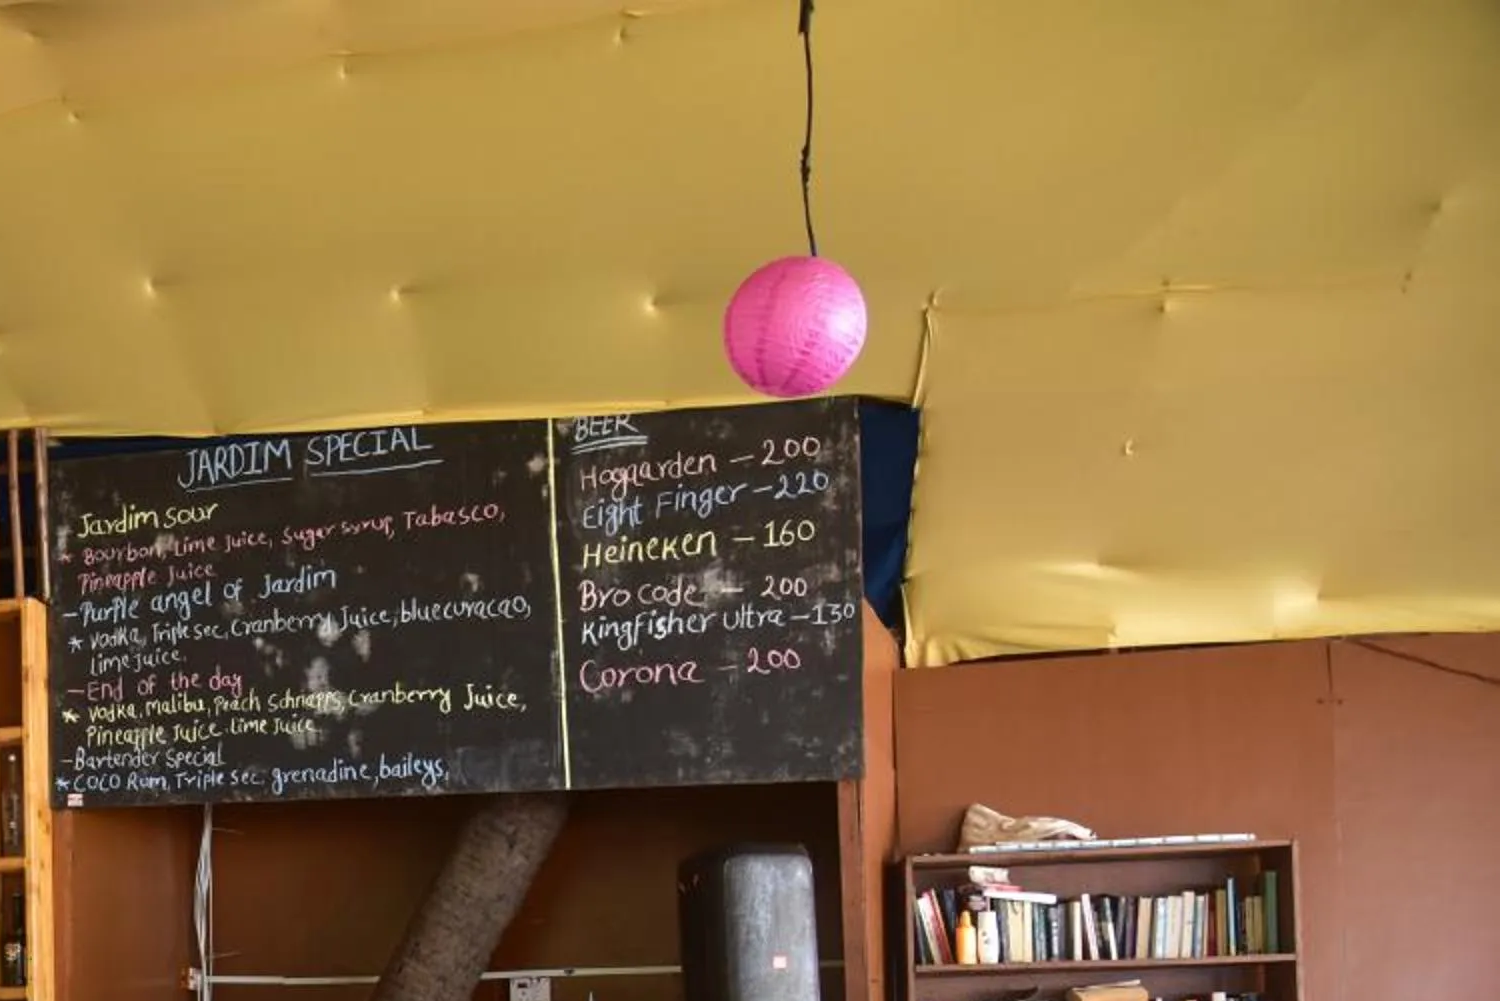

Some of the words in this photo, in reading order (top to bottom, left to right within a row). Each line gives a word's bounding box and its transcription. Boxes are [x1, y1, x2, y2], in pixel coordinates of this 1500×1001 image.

[574, 414, 639, 442] BEER
[177, 438, 292, 489] JARDIM
[304, 426, 434, 467] SPECIAL
[761, 436, 821, 466] 200
[77, 503, 159, 538] Jardim
[163, 503, 218, 529] sour
[582, 498, 643, 537] Eight
[655, 483, 748, 519] Finger
[583, 530, 716, 569] Heineken
[762, 519, 815, 549] 160
[150, 580, 213, 622] angel
[223, 577, 244, 603] of
[259, 565, 337, 599] Jardim
[579, 579, 632, 612] Bro
[760, 575, 808, 601] 200
[137, 677, 157, 697] of
[171, 672, 201, 694] the
[209, 664, 244, 698] day
[579, 658, 705, 694] Corona
[747, 648, 801, 674] 200
[85, 724, 168, 750] Pineapple
[165, 741, 226, 769] Special
[175, 770, 224, 791] Triple
